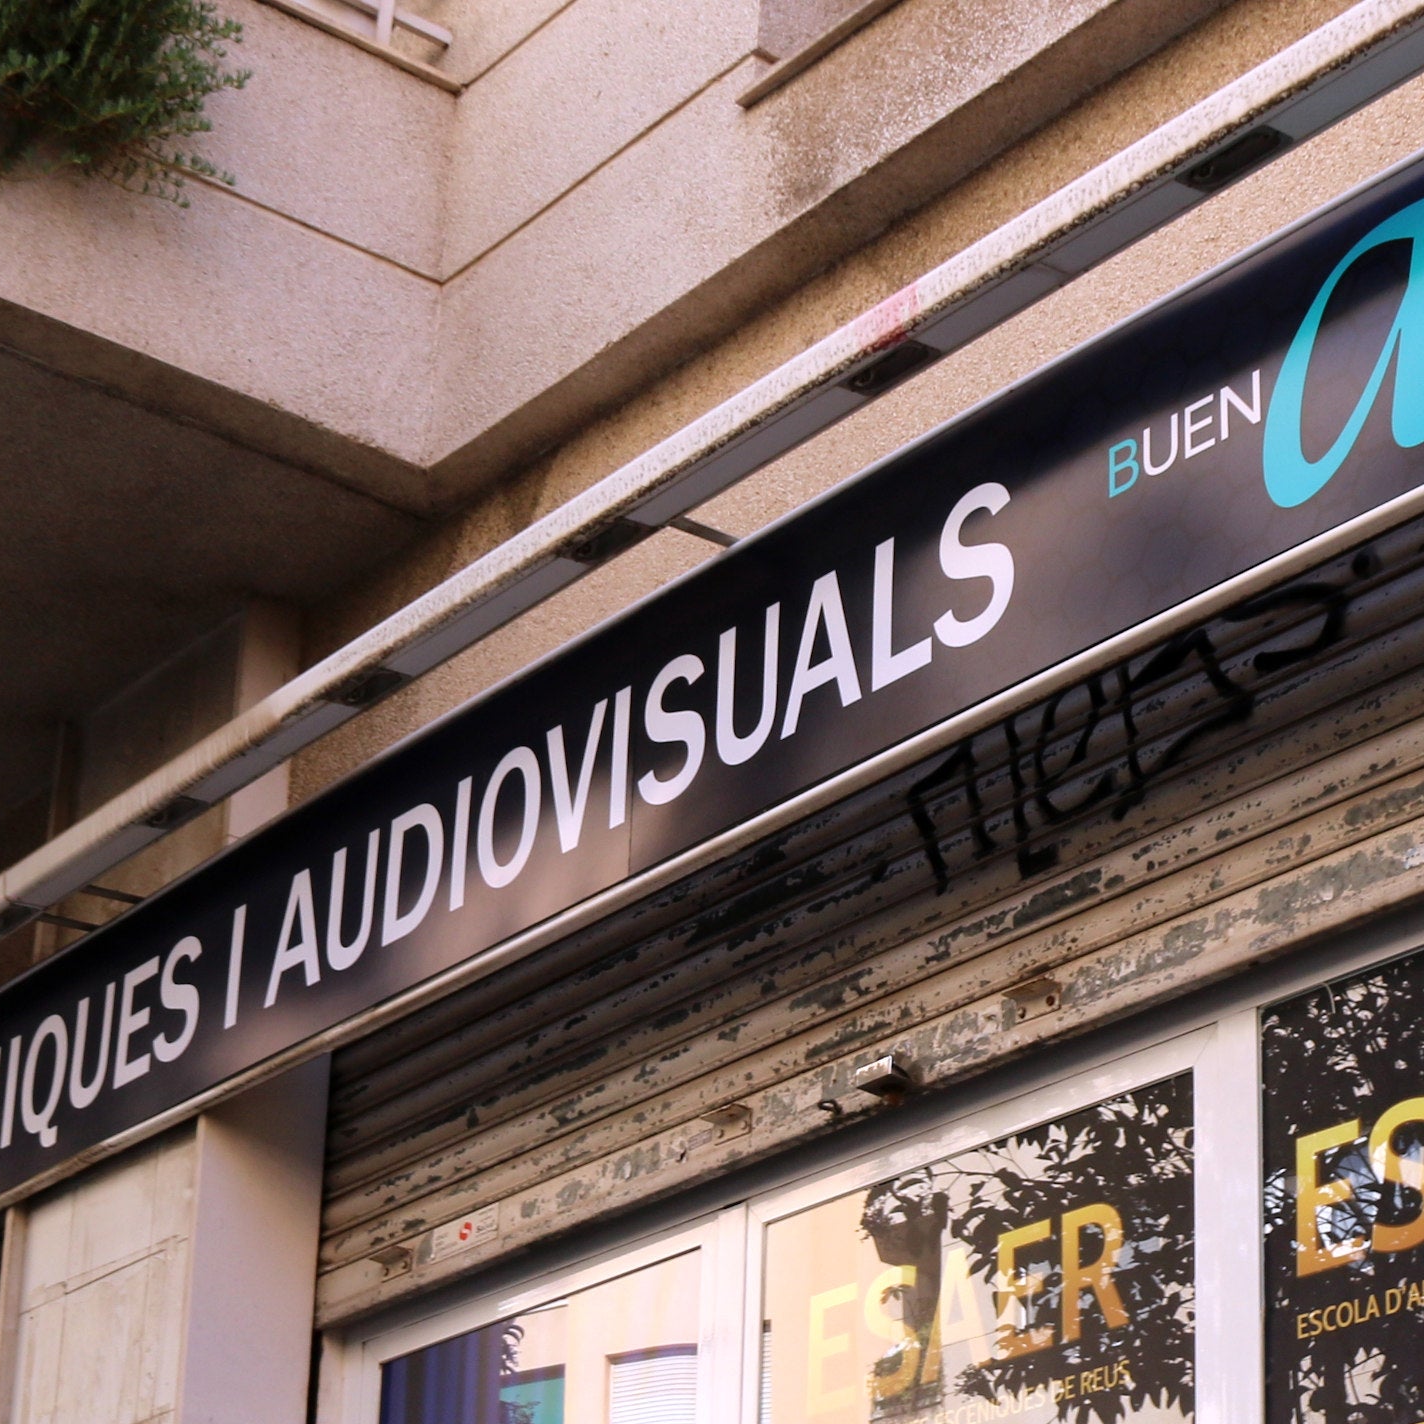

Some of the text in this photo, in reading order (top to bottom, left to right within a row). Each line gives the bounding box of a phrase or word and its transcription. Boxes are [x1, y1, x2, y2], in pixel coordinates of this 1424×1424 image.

[223, 904, 248, 1030] I
[263, 482, 1017, 1009] AUDIOVISUALS
[806, 1203, 1130, 1417] ESAER
[1296, 1295, 1380, 1339] ESCOLA
[1051, 1374, 1076, 1403] DE
[1079, 1360, 1133, 1395] REUS
